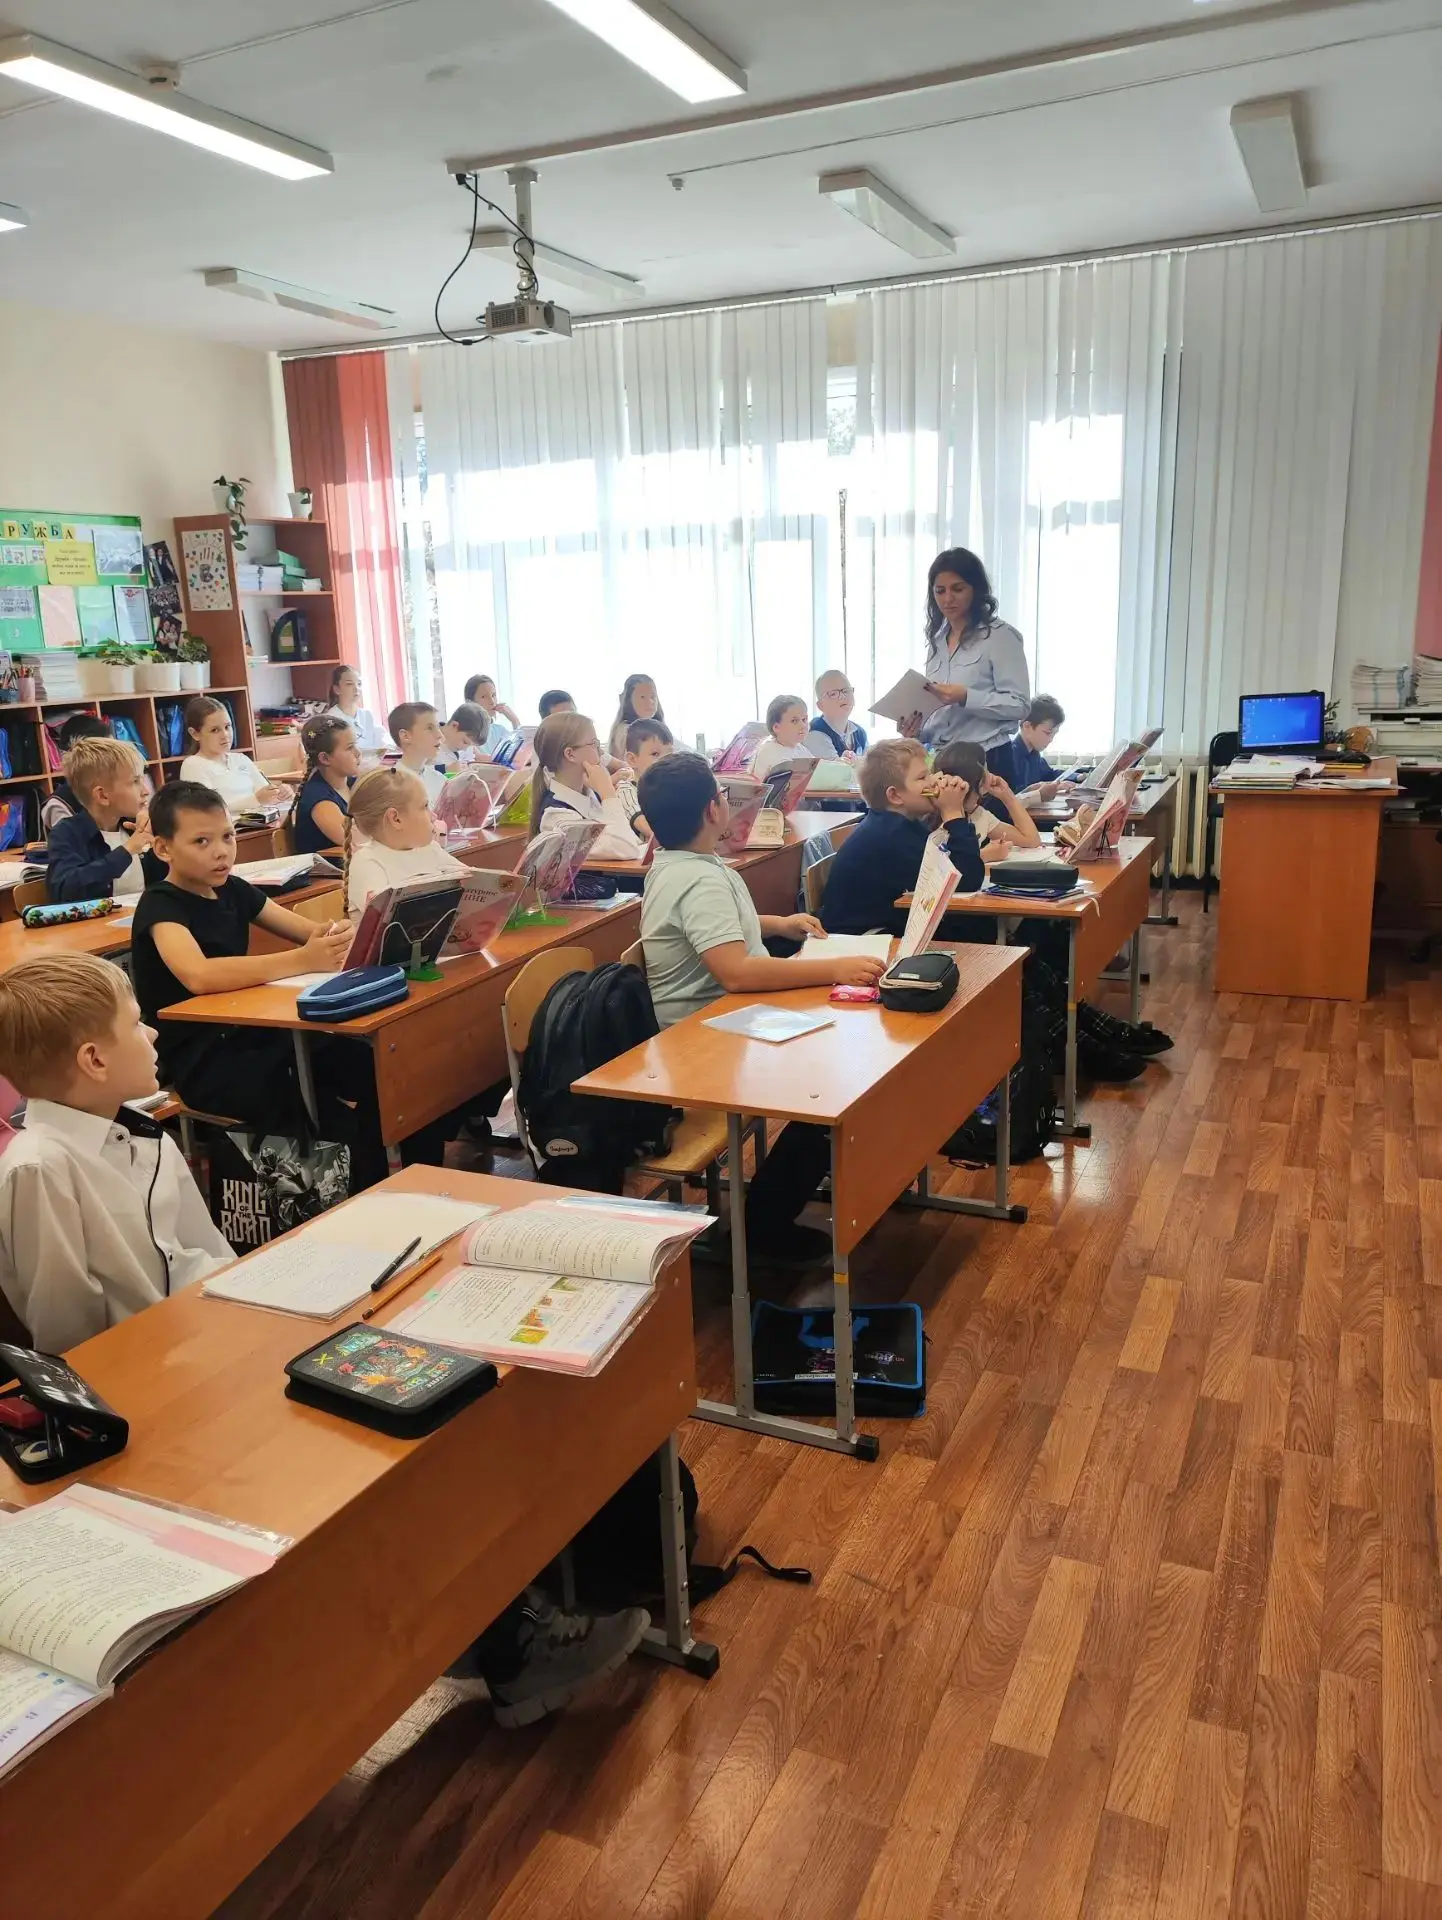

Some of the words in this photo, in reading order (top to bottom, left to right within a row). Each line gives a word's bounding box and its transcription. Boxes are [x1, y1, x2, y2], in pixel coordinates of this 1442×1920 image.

[0, 523, 73, 539] РУЖБА
[222, 1179, 266, 1214] KING
[220, 1210, 271, 1245] ROAD
